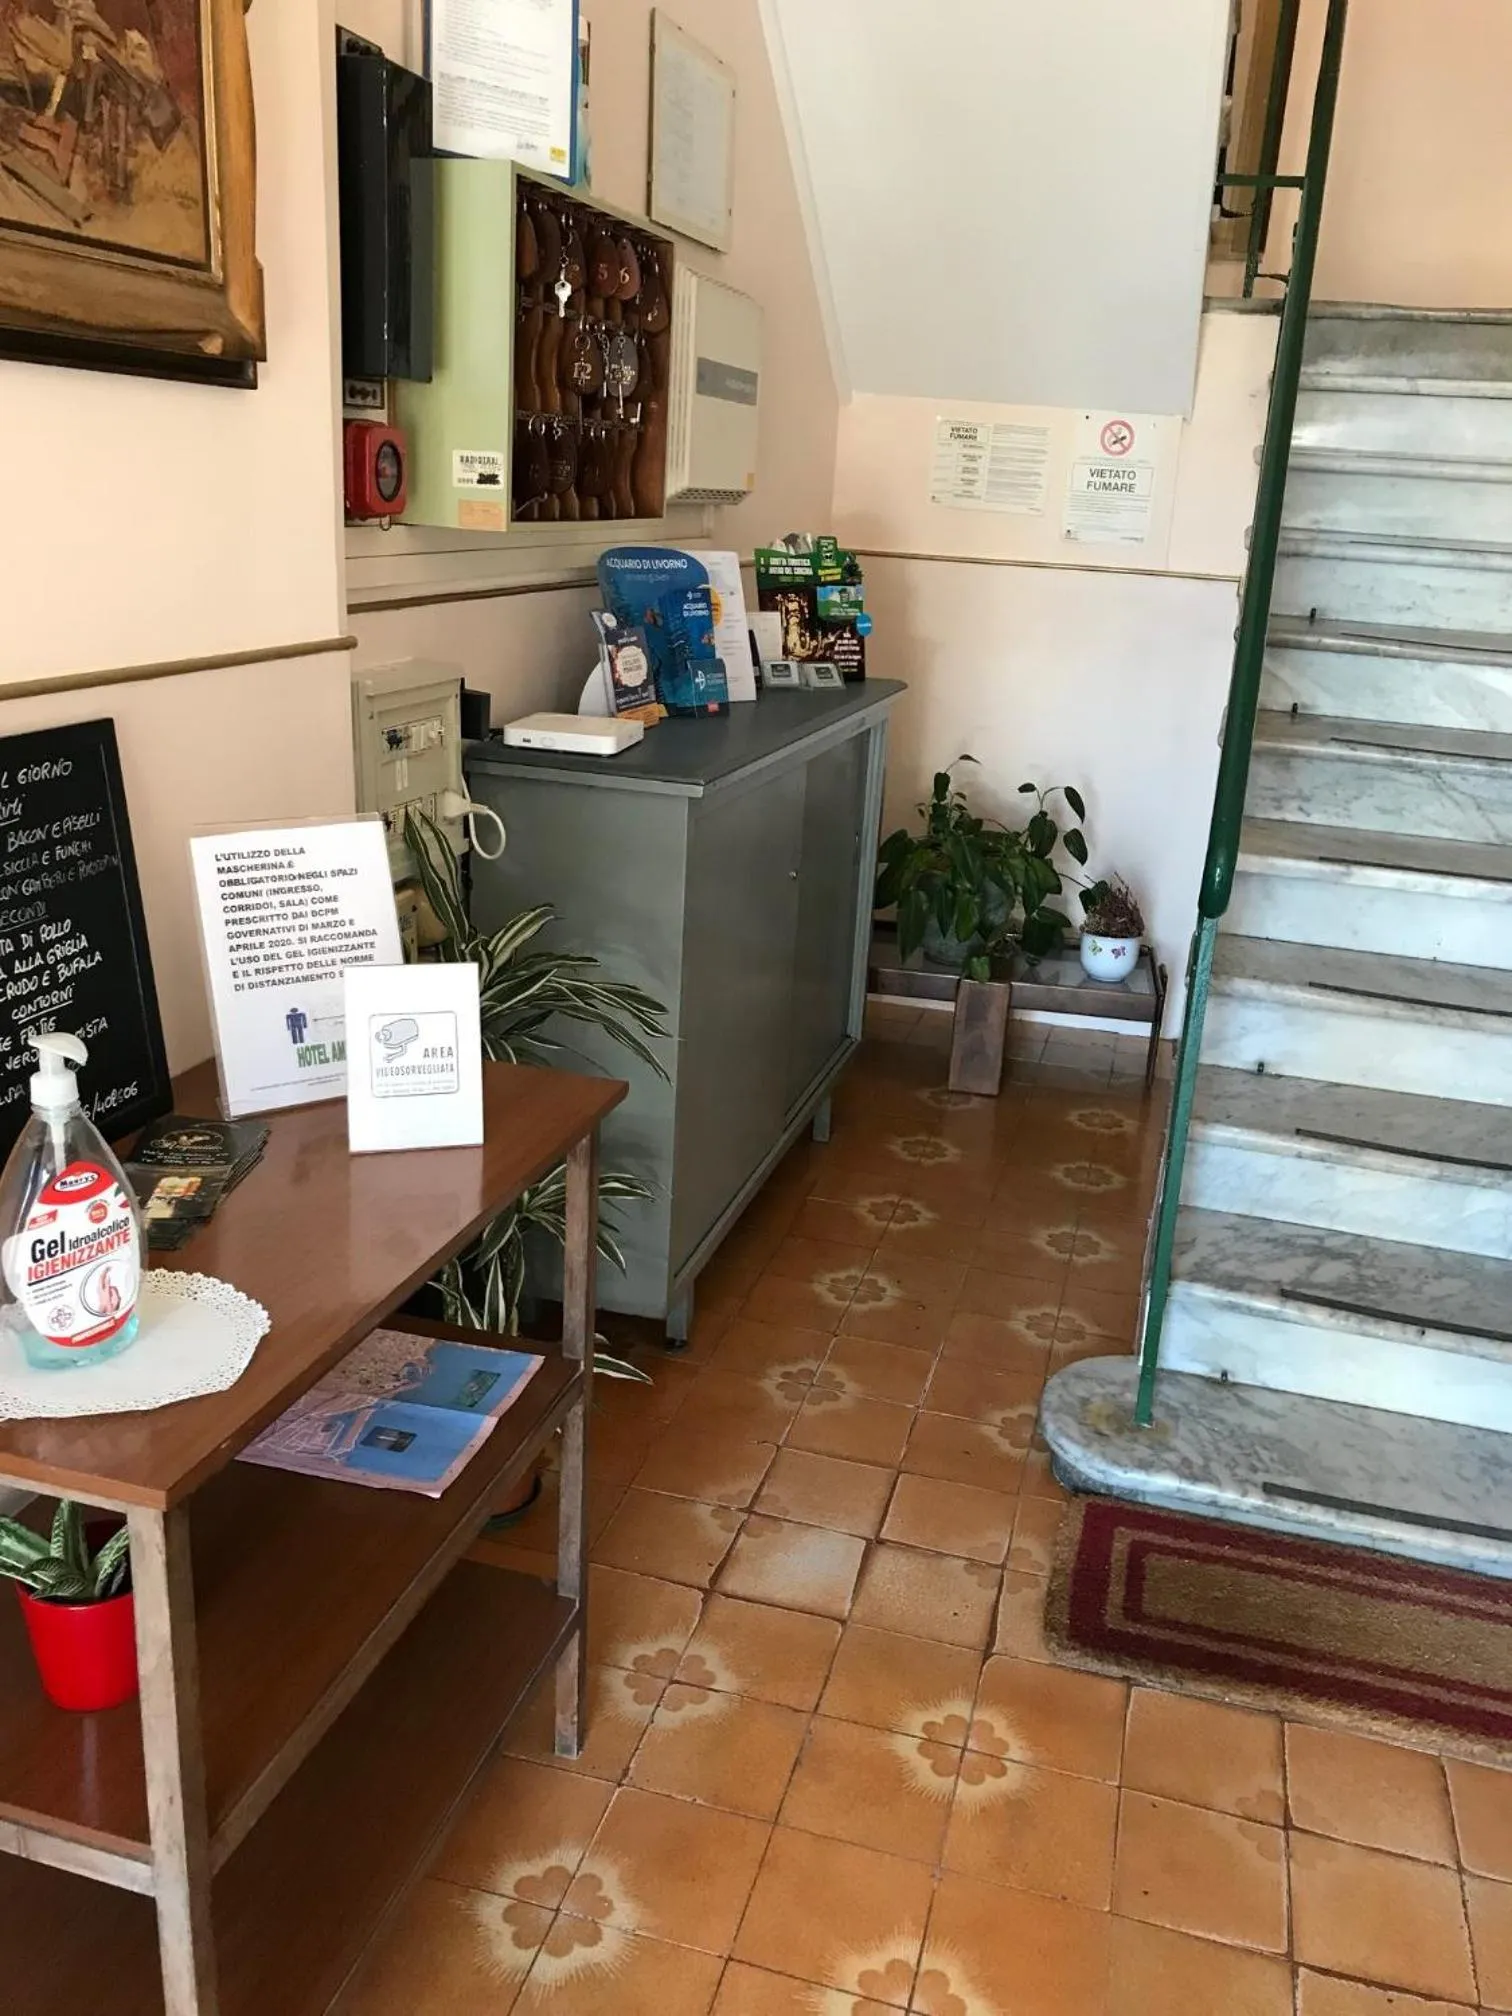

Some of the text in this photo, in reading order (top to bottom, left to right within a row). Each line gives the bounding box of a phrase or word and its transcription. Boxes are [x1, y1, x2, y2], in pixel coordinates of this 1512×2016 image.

[620, 267, 630, 284] 6
[949, 432, 978, 441] FUMARE
[950, 426, 978, 434] VIETATO
[1089, 467, 1137, 481] VIETATO
[1086, 480, 1136, 493] FUMARE
[606, 558, 688, 570] ACQUARIO DI LIVORNO
[17, 757, 73, 784] GIORNO
[8, 824, 49, 852] BACON
[52, 822, 61, 838] E
[0, 853, 39, 877] SICCIA
[42, 851, 50, 865] E
[215, 847, 306, 862] L'UTILIZZO DELLA
[217, 861, 285, 874] MASCHERINA
[219, 868, 358, 887] OBBLIGATORIO NEGLI SPAZI
[221, 889, 263, 900] COMUNI
[223, 895, 339, 913] CORRIDOI, SALA) COME
[225, 912, 289, 927] PRESCRITTO
[292, 910, 308, 920] DAI
[226, 918, 355, 940] GOVERNATIVI DI MARZO E
[21, 930, 34, 950] DI
[39, 919, 72, 942] POLLO
[229, 928, 378, 953] APRILE 2020. SI RACCOMANDA
[14, 952, 44, 975] ALLA
[47, 933, 89, 964] GRIGLIA
[230, 941, 376, 966] L'USO DEL GEL IGIENIZZANTE
[42, 970, 51, 986] E
[57, 951, 103, 983] BUFALA
[232, 953, 375, 979] E IL RISPETTO DELLE NORME
[234, 983, 245, 992] DI
[247, 971, 336, 990] DISTANZIAMENTO
[12, 983, 75, 1020] CONTORNI
[296, 1042, 329, 1068] HOTEL
[423, 1046, 454, 1058] AREA
[376, 1063, 454, 1078] VIDEOSORVEGLIATA
[27, 1228, 131, 1282] IGIENIZZANTE
[31, 1230, 65, 1264] Gel
